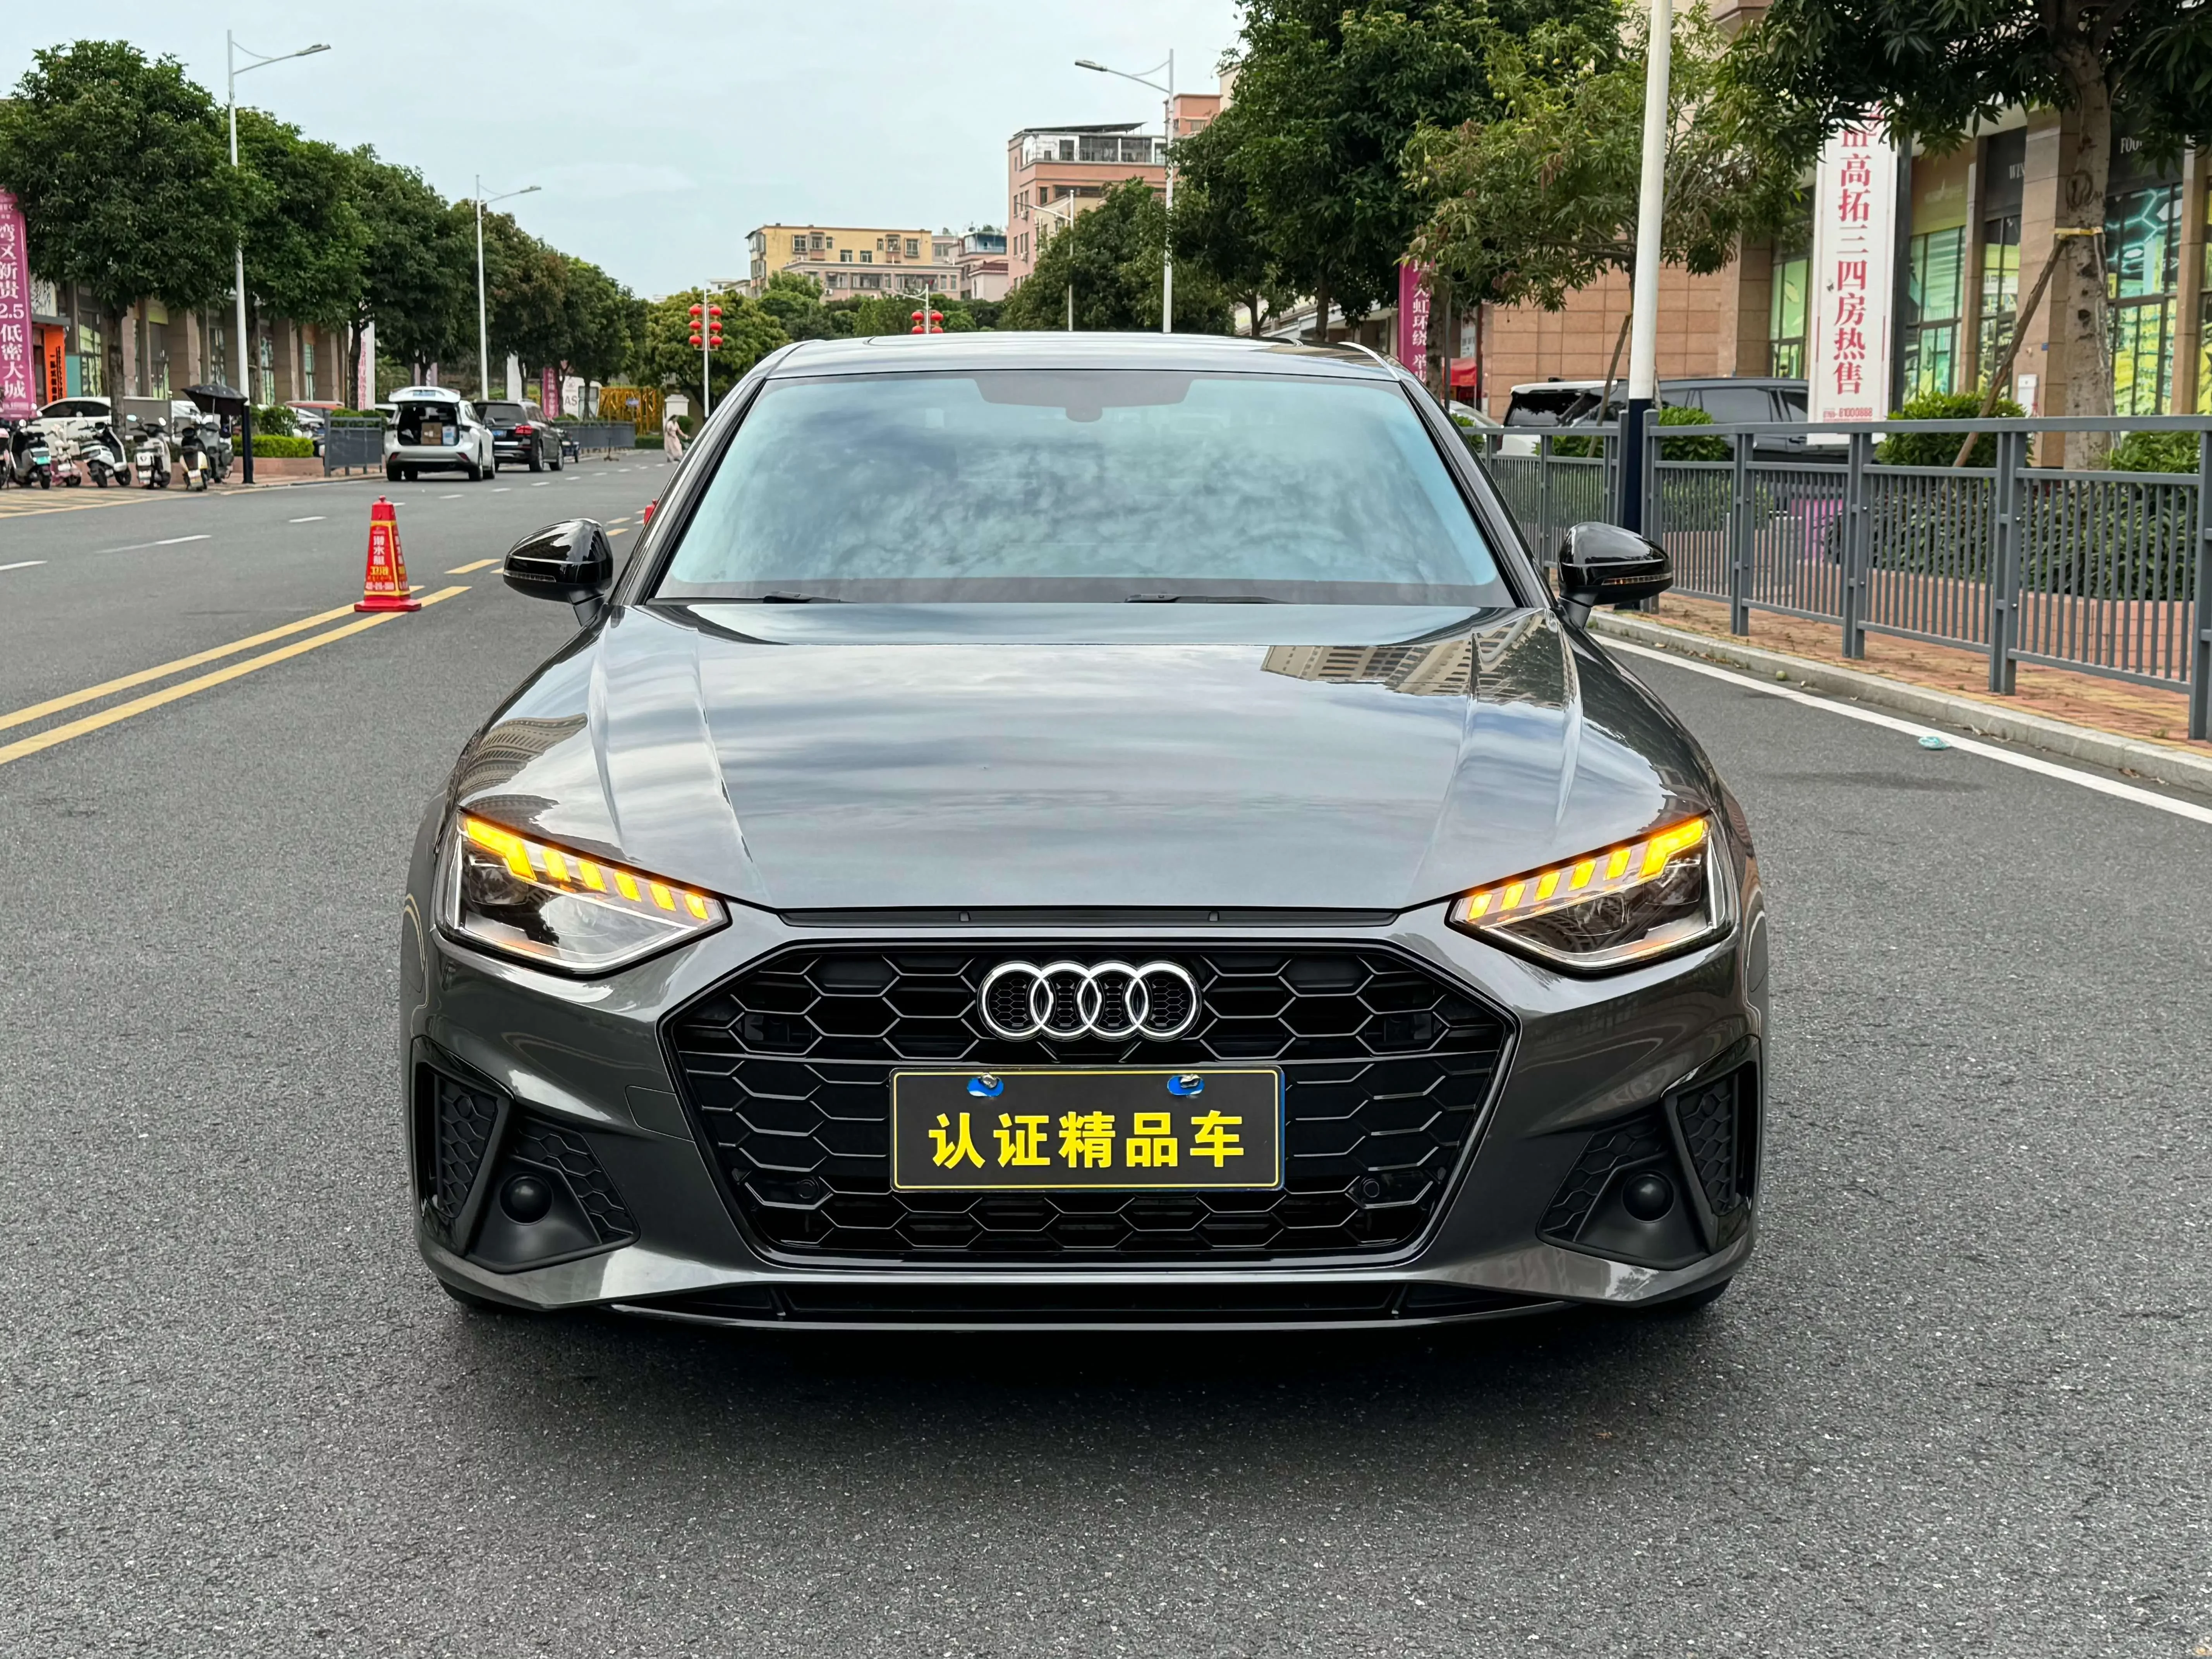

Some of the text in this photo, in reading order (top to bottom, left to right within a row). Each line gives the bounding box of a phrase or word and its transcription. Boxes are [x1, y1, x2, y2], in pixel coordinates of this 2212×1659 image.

[929, 1111, 1244, 1169] 认证精品车
